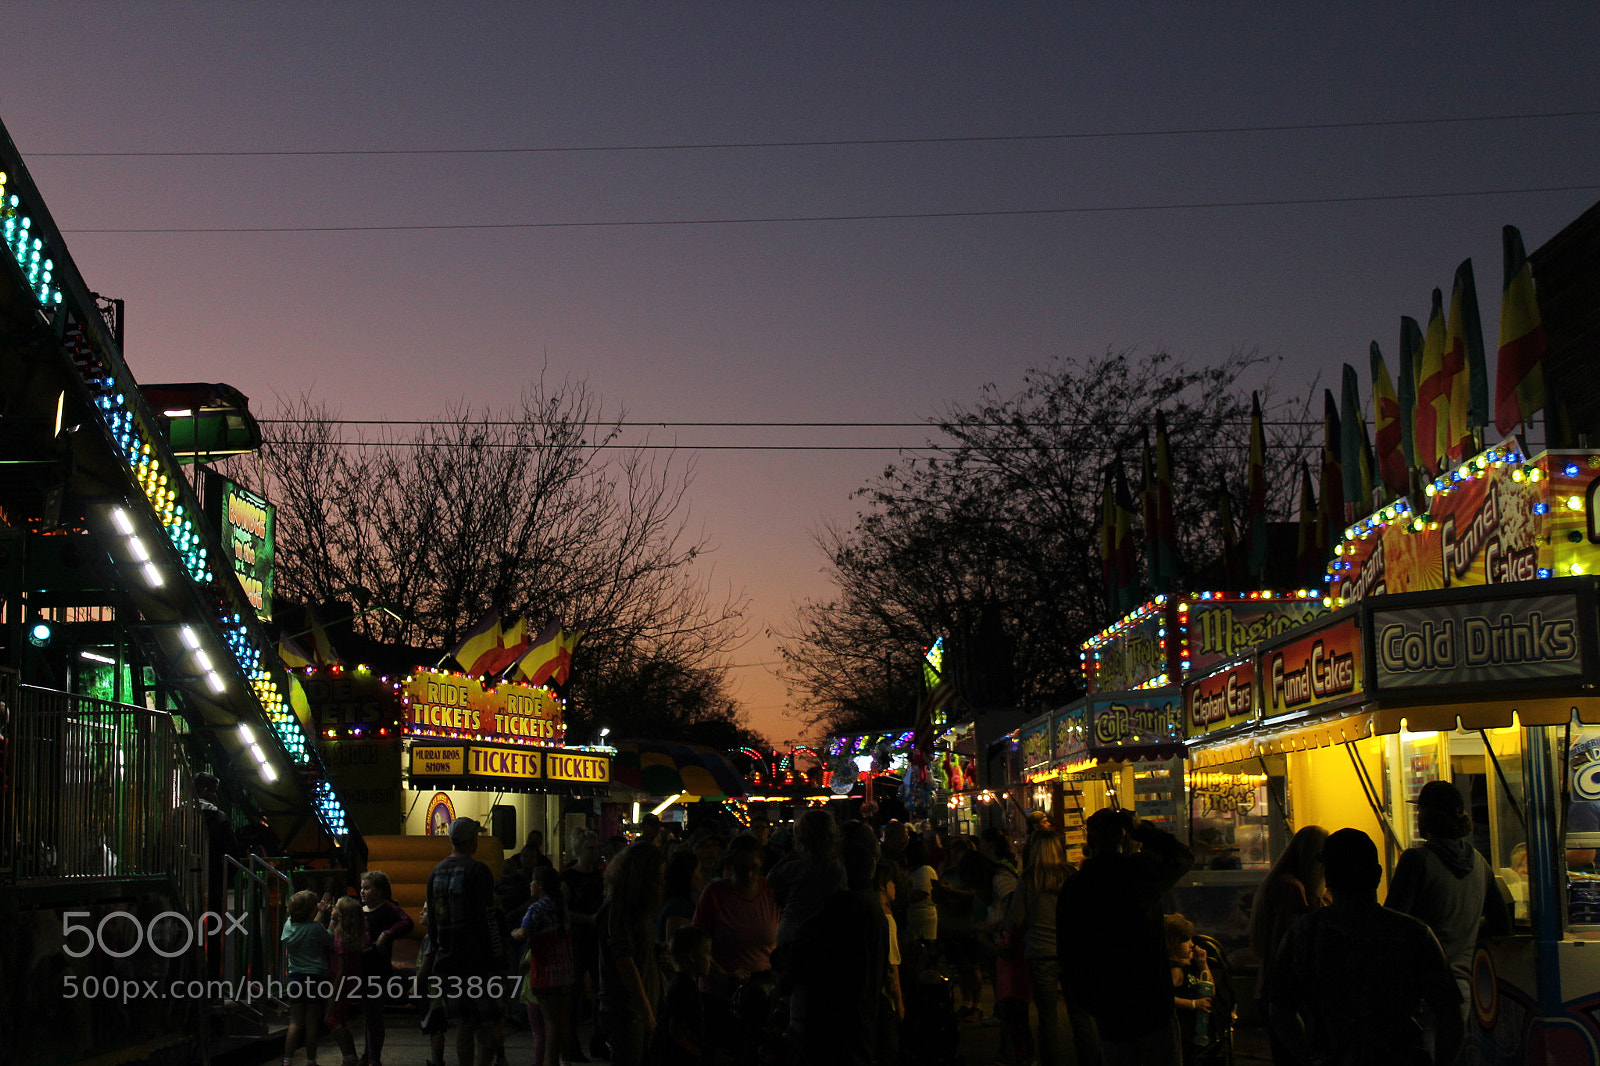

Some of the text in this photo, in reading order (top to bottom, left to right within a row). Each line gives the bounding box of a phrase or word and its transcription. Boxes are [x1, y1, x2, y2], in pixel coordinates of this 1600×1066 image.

[229, 492, 267, 540] RUMBLE
[1442, 480, 1500, 588] Funnel
[1485, 534, 1537, 586] Cakes
[1380, 611, 1578, 674] Cold Drinks
[1272, 639, 1354, 709] Funnel Cakes
[427, 682, 469, 707] RIDE
[507, 694, 543, 717] RIDE
[1192, 671, 1251, 731] Elephant Ears
[412, 703, 481, 730] TICKETS
[494, 714, 554, 739] TICKETS
[1097, 703, 1130, 743] Cold
[425, 762, 450, 773] SHOWS
[472, 749, 538, 775] TICKETS
[550, 756, 606, 780] TICKETS
[1193, 789, 1256, 818] Treats
